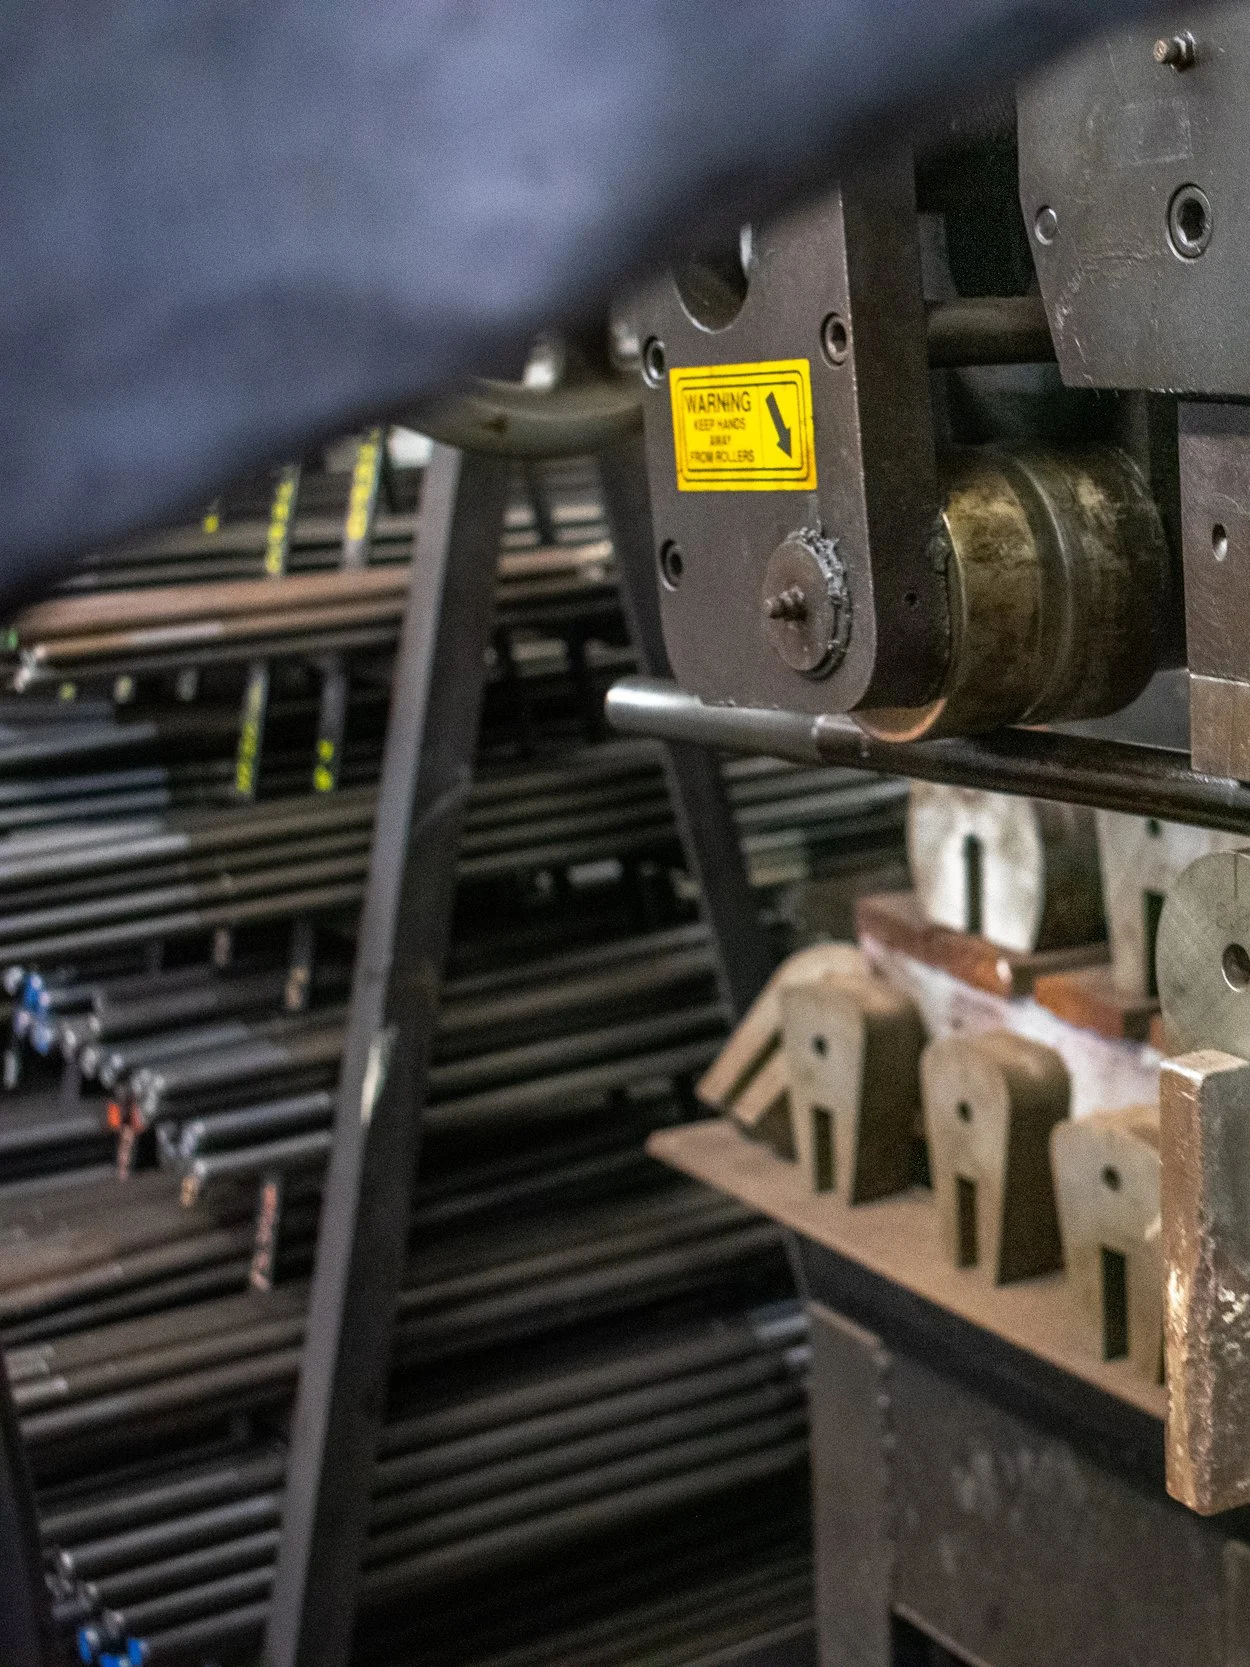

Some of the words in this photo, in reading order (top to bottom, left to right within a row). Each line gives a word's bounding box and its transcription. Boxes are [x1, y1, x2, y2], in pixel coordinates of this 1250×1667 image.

[685, 391, 752, 414] WARNING
[694, 418, 715, 431] KEEP
[710, 435, 731, 446] AWAY
[690, 451, 714, 463] FROM
[715, 450, 755, 463] ROLLERS
